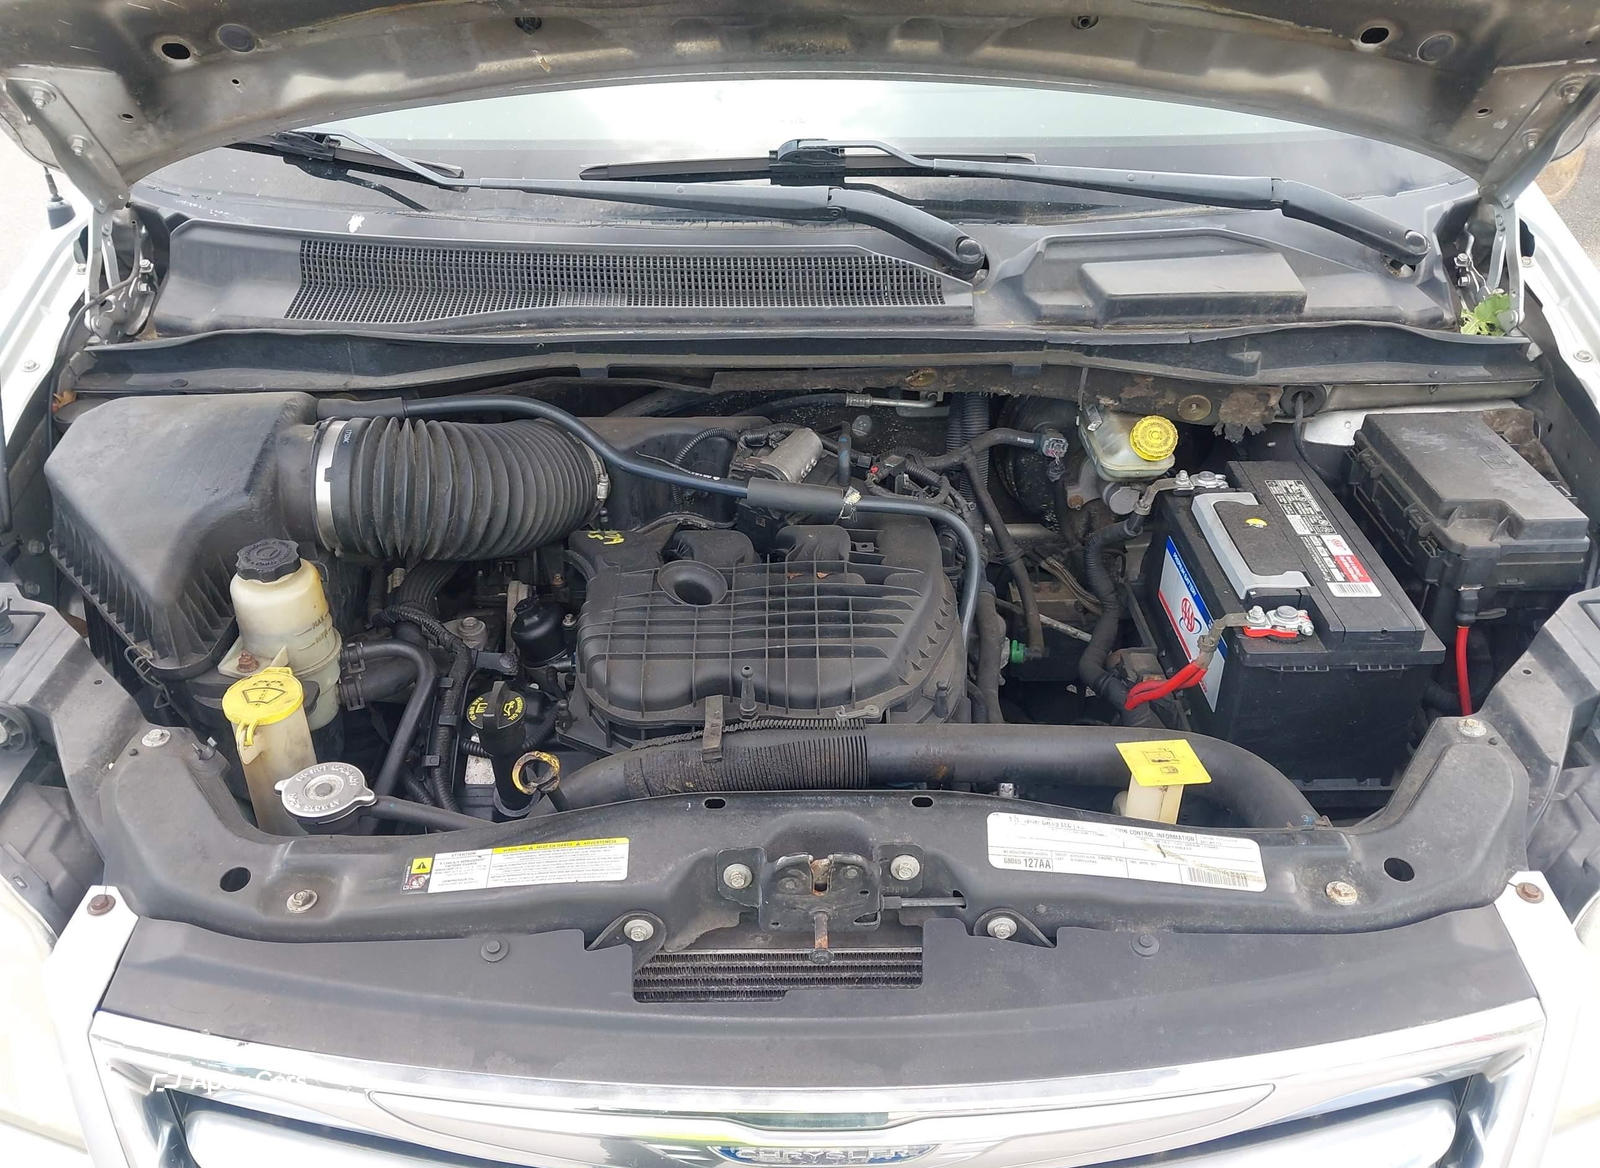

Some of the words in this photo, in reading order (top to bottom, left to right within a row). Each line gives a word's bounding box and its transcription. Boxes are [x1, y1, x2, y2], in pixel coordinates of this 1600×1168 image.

[1129, 829, 1155, 838] CONTROL
[1156, 833, 1195, 842] INFORMATION
[1024, 858, 1052, 869] 127AA
[735, 1146, 909, 1163] CHRYSLER
